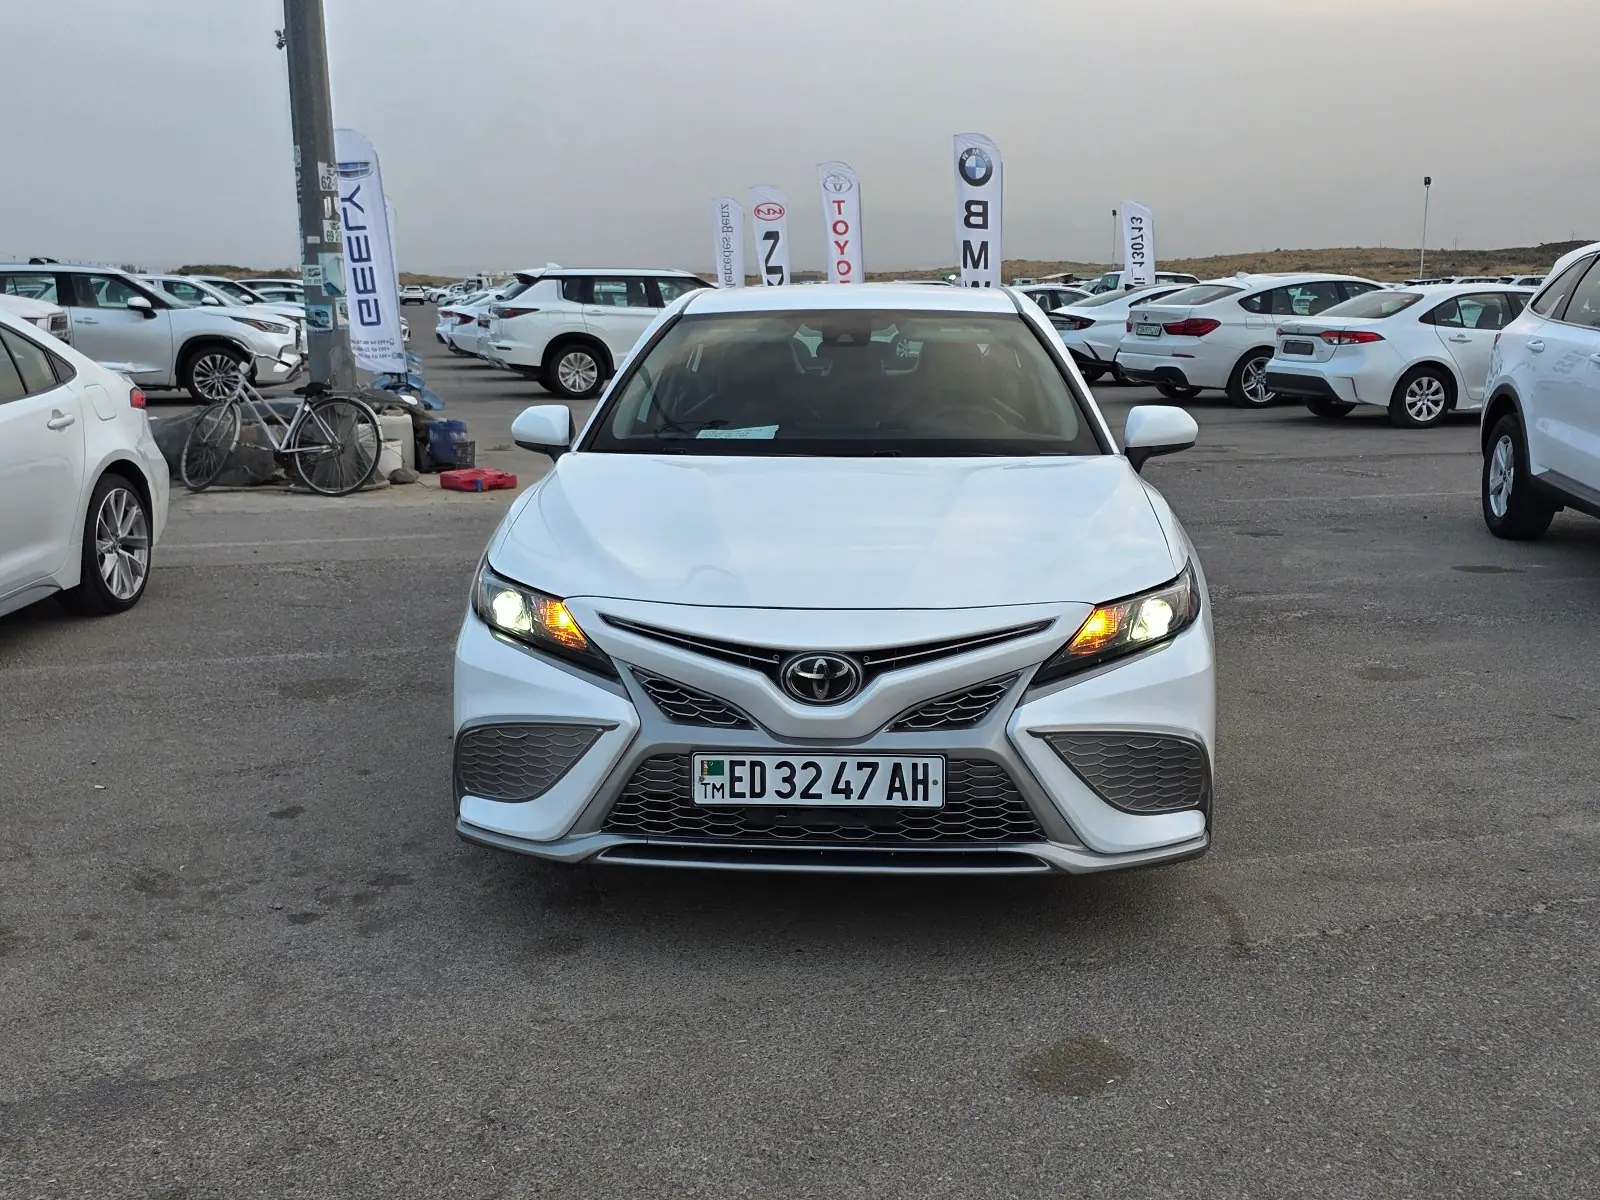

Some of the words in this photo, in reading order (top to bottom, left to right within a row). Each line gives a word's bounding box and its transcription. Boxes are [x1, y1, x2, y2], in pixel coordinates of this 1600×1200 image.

[831, 200, 852, 284] TOYO
[701, 783, 725, 799] TM
[729, 760, 767, 799] ED
[774, 760, 823, 800] 32
[831, 761, 880, 800] 47
[886, 762, 930, 802] AH
